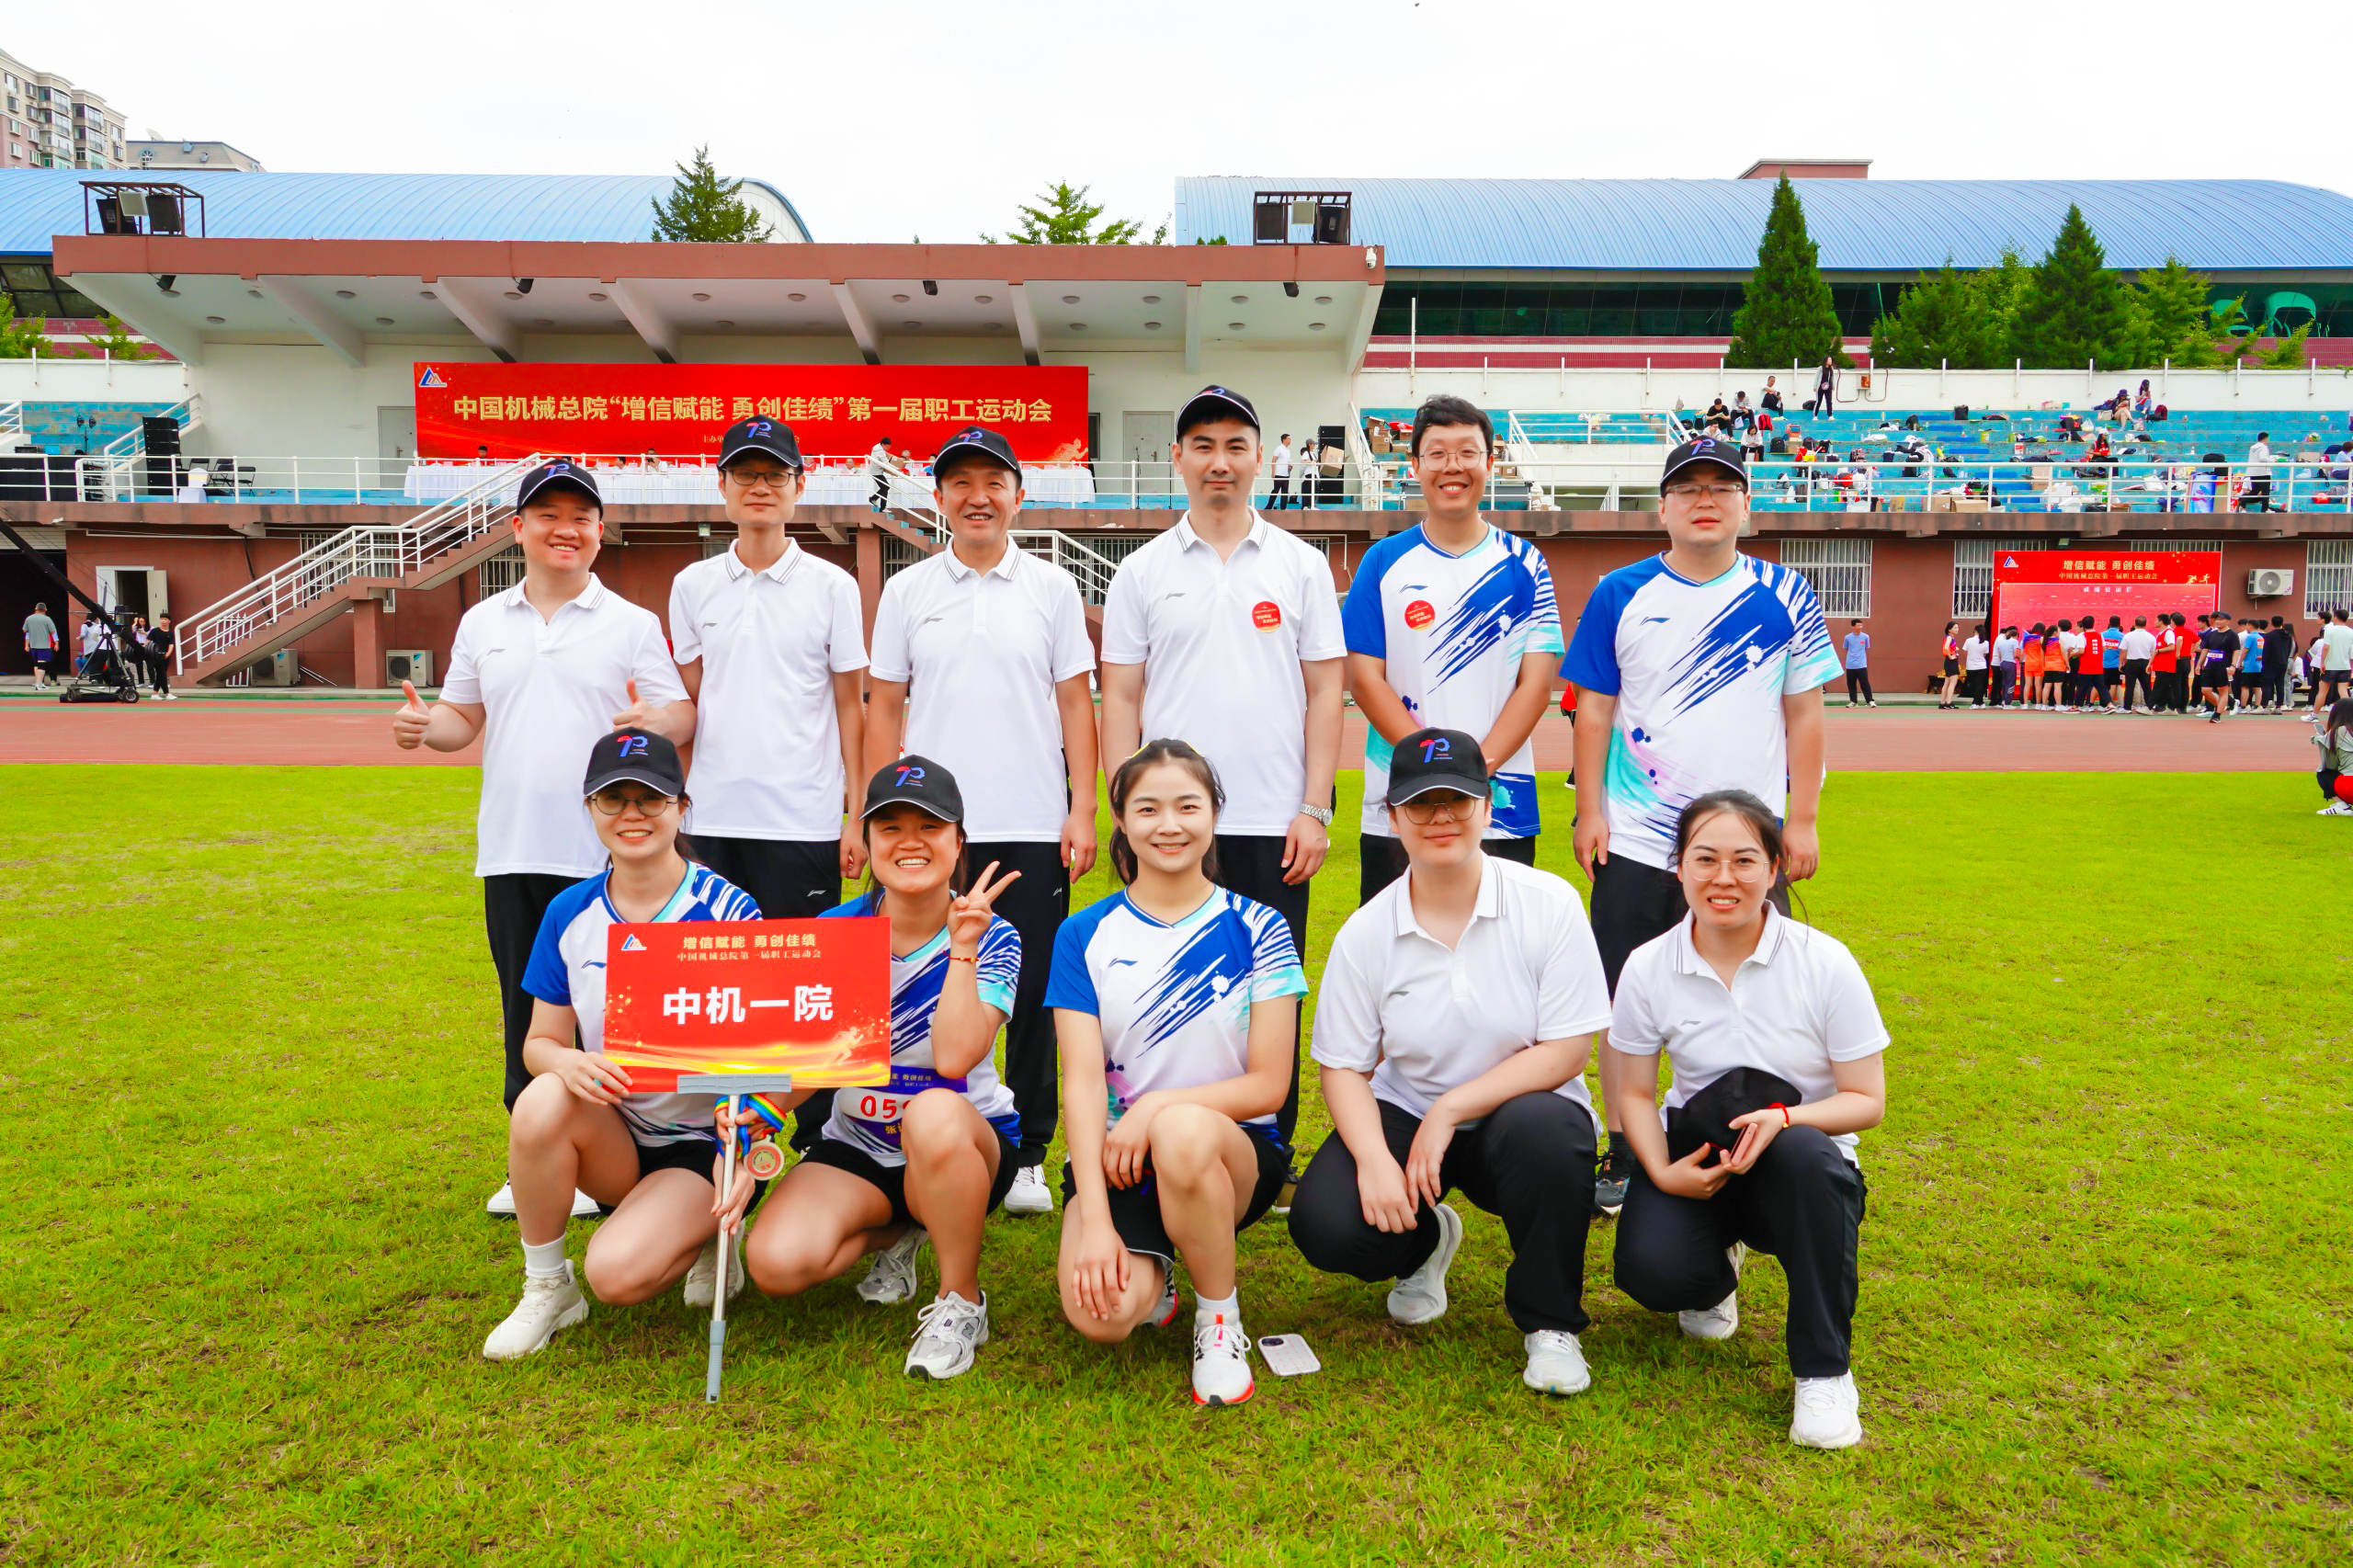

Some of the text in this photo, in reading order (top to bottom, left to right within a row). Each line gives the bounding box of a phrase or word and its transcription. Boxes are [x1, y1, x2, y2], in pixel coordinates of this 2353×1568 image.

[453, 395, 1052, 423] 中国机械总院“增信赋能 勇创佳绩”第一届职工运动会
[2063, 560, 2155, 571] 增信赋能 勇创佳绩
[683, 934, 816, 949] 增信赋能 勇创佳绩
[676, 949, 822, 962] 中国机械总院第一届职工运动会
[662, 983, 834, 1026] 中机一院
[859, 1095, 911, 1119] 05
